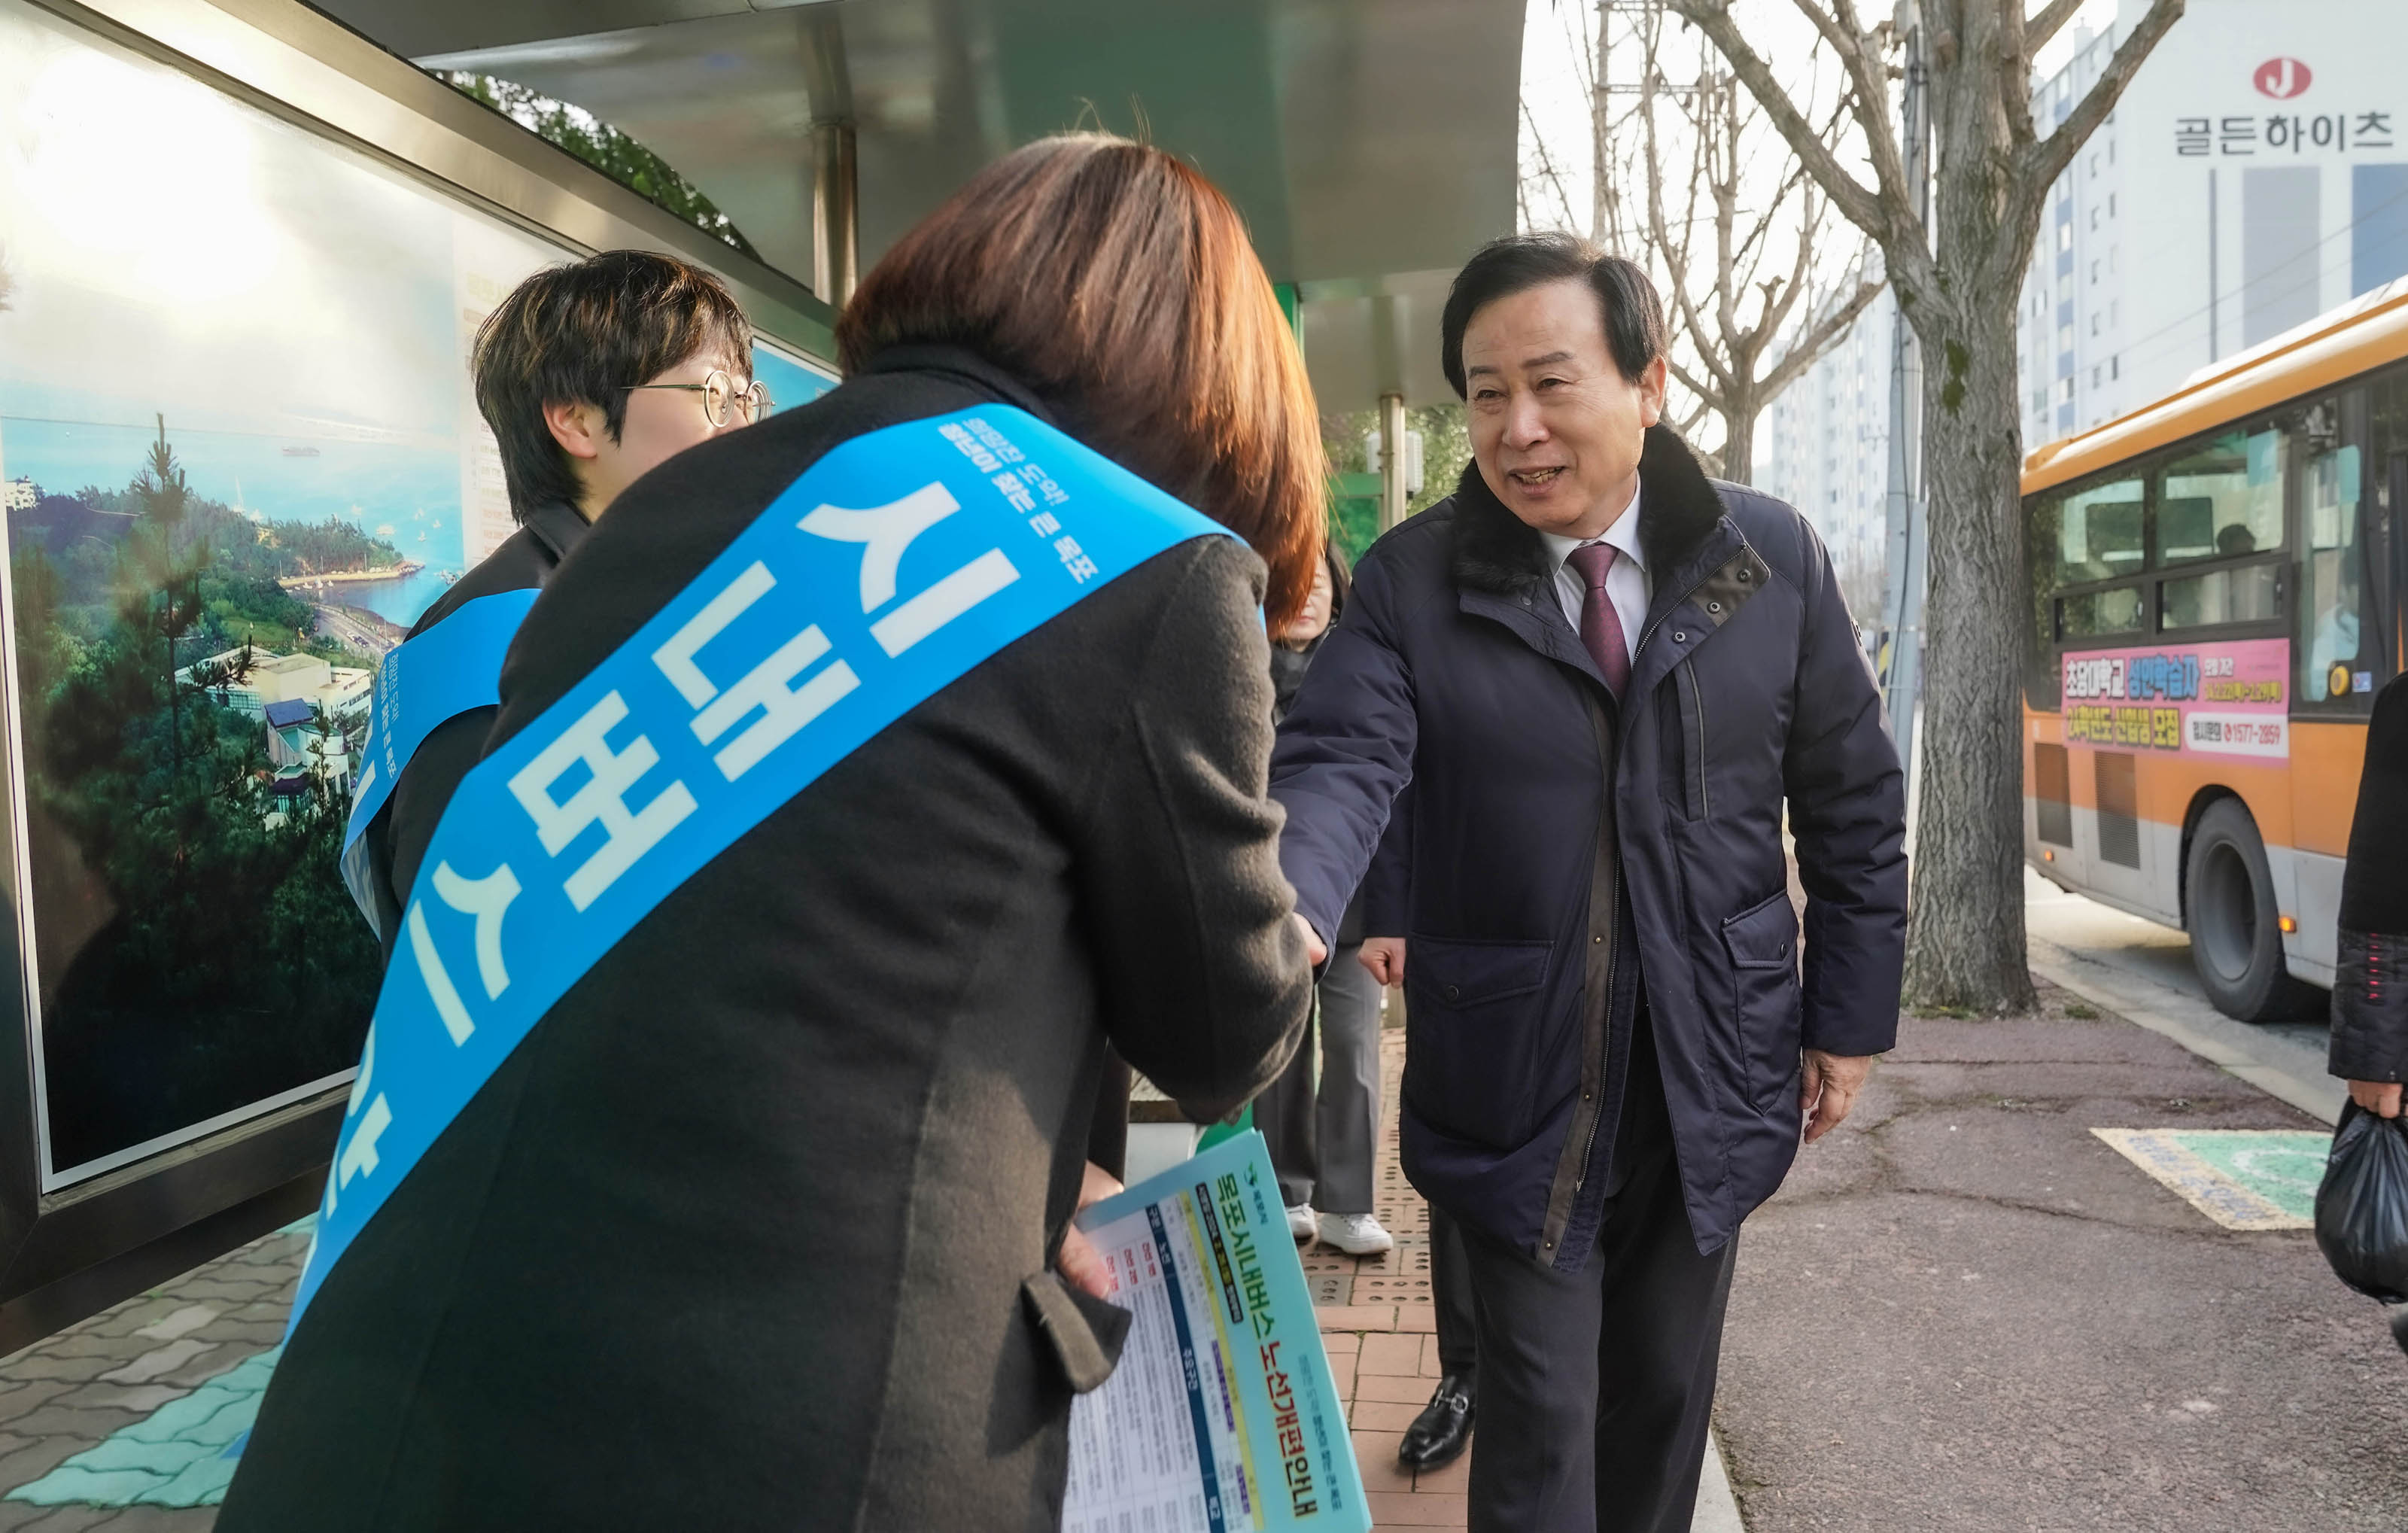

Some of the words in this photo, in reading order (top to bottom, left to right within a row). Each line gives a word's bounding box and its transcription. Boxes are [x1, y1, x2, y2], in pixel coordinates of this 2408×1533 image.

[2175, 112, 2394, 156] 골든하이츠
[962, 418, 1026, 464] 희망찬
[938, 422, 1003, 474] 청년이
[990, 471, 1037, 515] 찾는
[1028, 511, 1062, 539] 큰
[1053, 534, 1099, 585] 목포
[388, 653, 399, 692] 희망찬
[2066, 657, 2125, 698] 초당대학교
[2128, 652, 2200, 699] 성인학습자
[2115, 707, 2151, 746] 신입생
[2154, 707, 2180, 749] 모집
[386, 748, 397, 778] 목포
[1158, 1243, 1170, 1264] 노선
[1181, 1347, 1198, 1390] 주요구간
[1216, 1173, 1276, 1339] 목포시내버스
[1260, 1340, 1318, 1517] 노선개편안내
